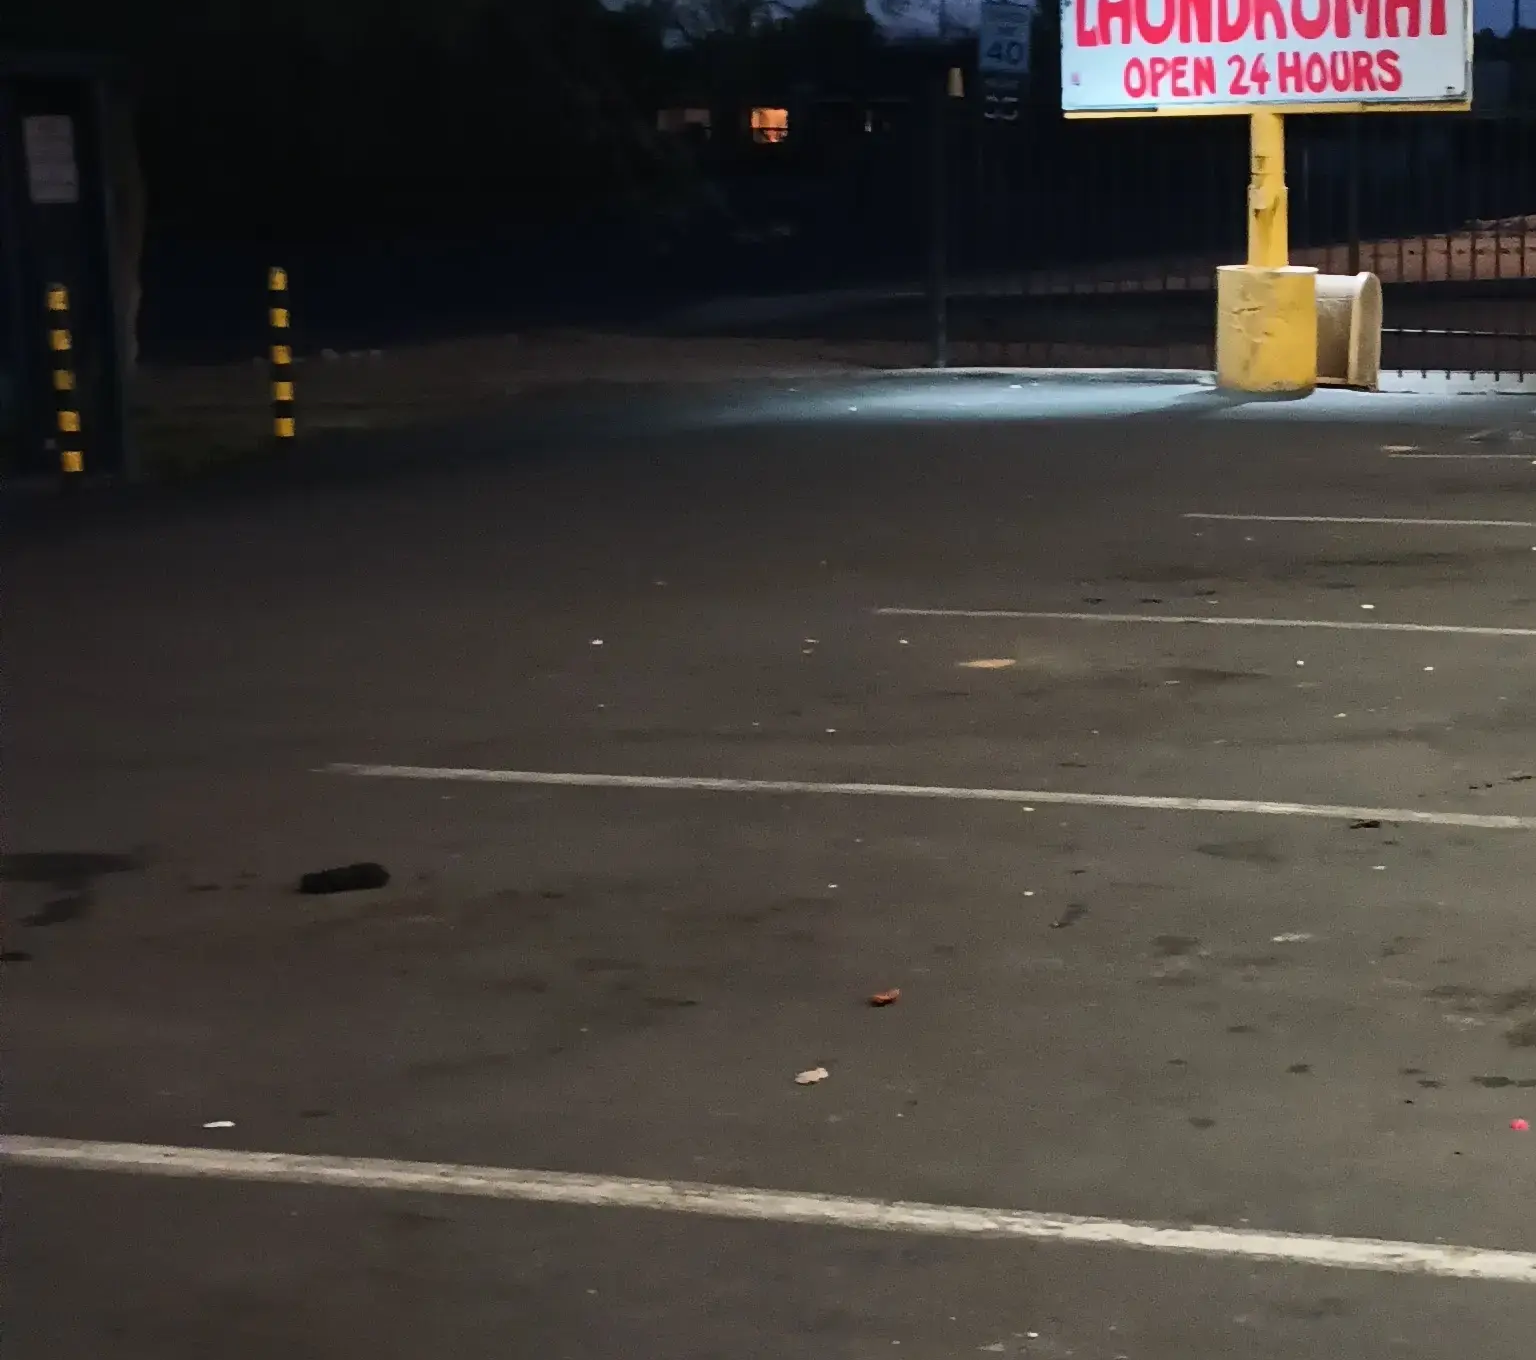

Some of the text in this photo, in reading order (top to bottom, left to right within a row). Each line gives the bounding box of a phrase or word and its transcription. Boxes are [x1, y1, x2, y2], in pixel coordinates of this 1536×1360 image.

[1123, 49, 1403, 99] OPEN 24 HOURS
